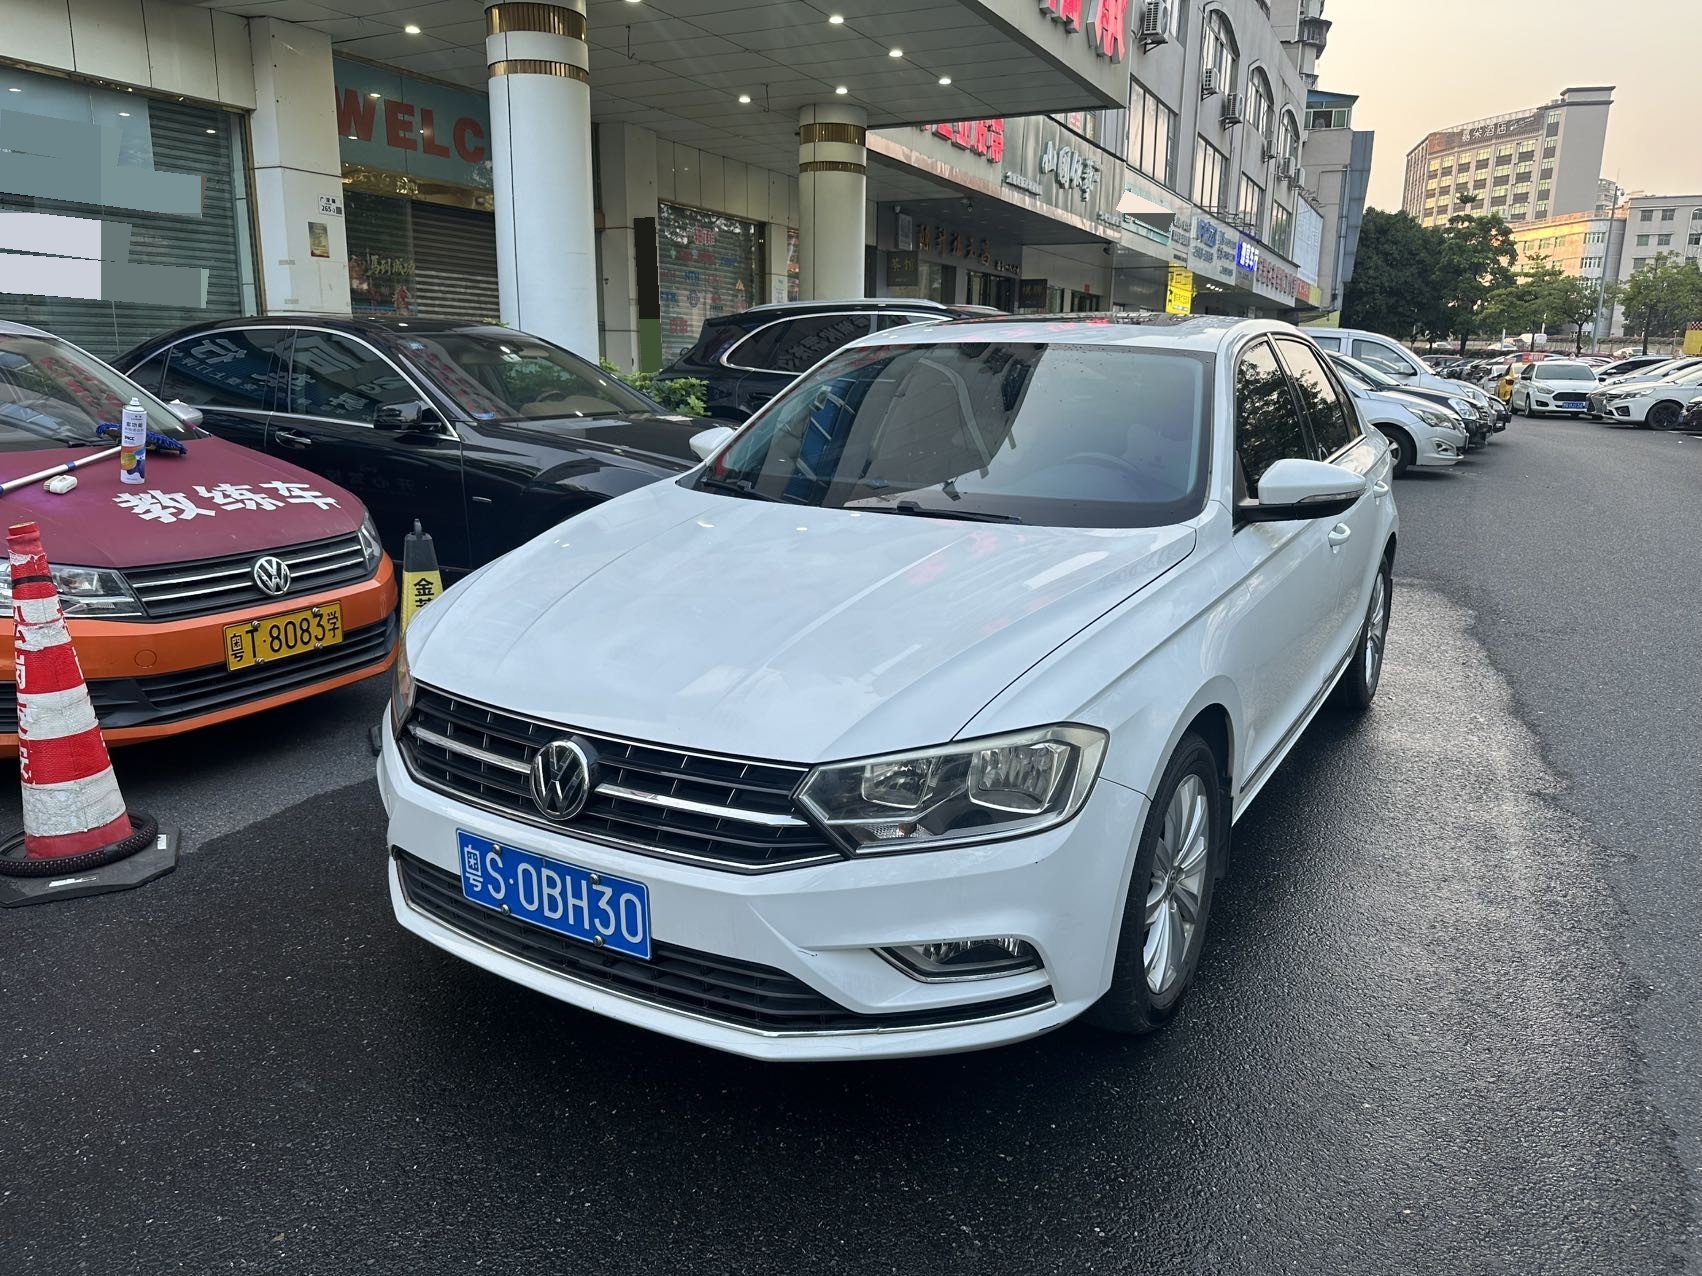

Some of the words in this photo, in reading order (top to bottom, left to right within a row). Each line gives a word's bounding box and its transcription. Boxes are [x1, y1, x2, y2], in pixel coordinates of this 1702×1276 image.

[335, 84, 486, 163] WELC
[112, 480, 341, 524] 教练车
